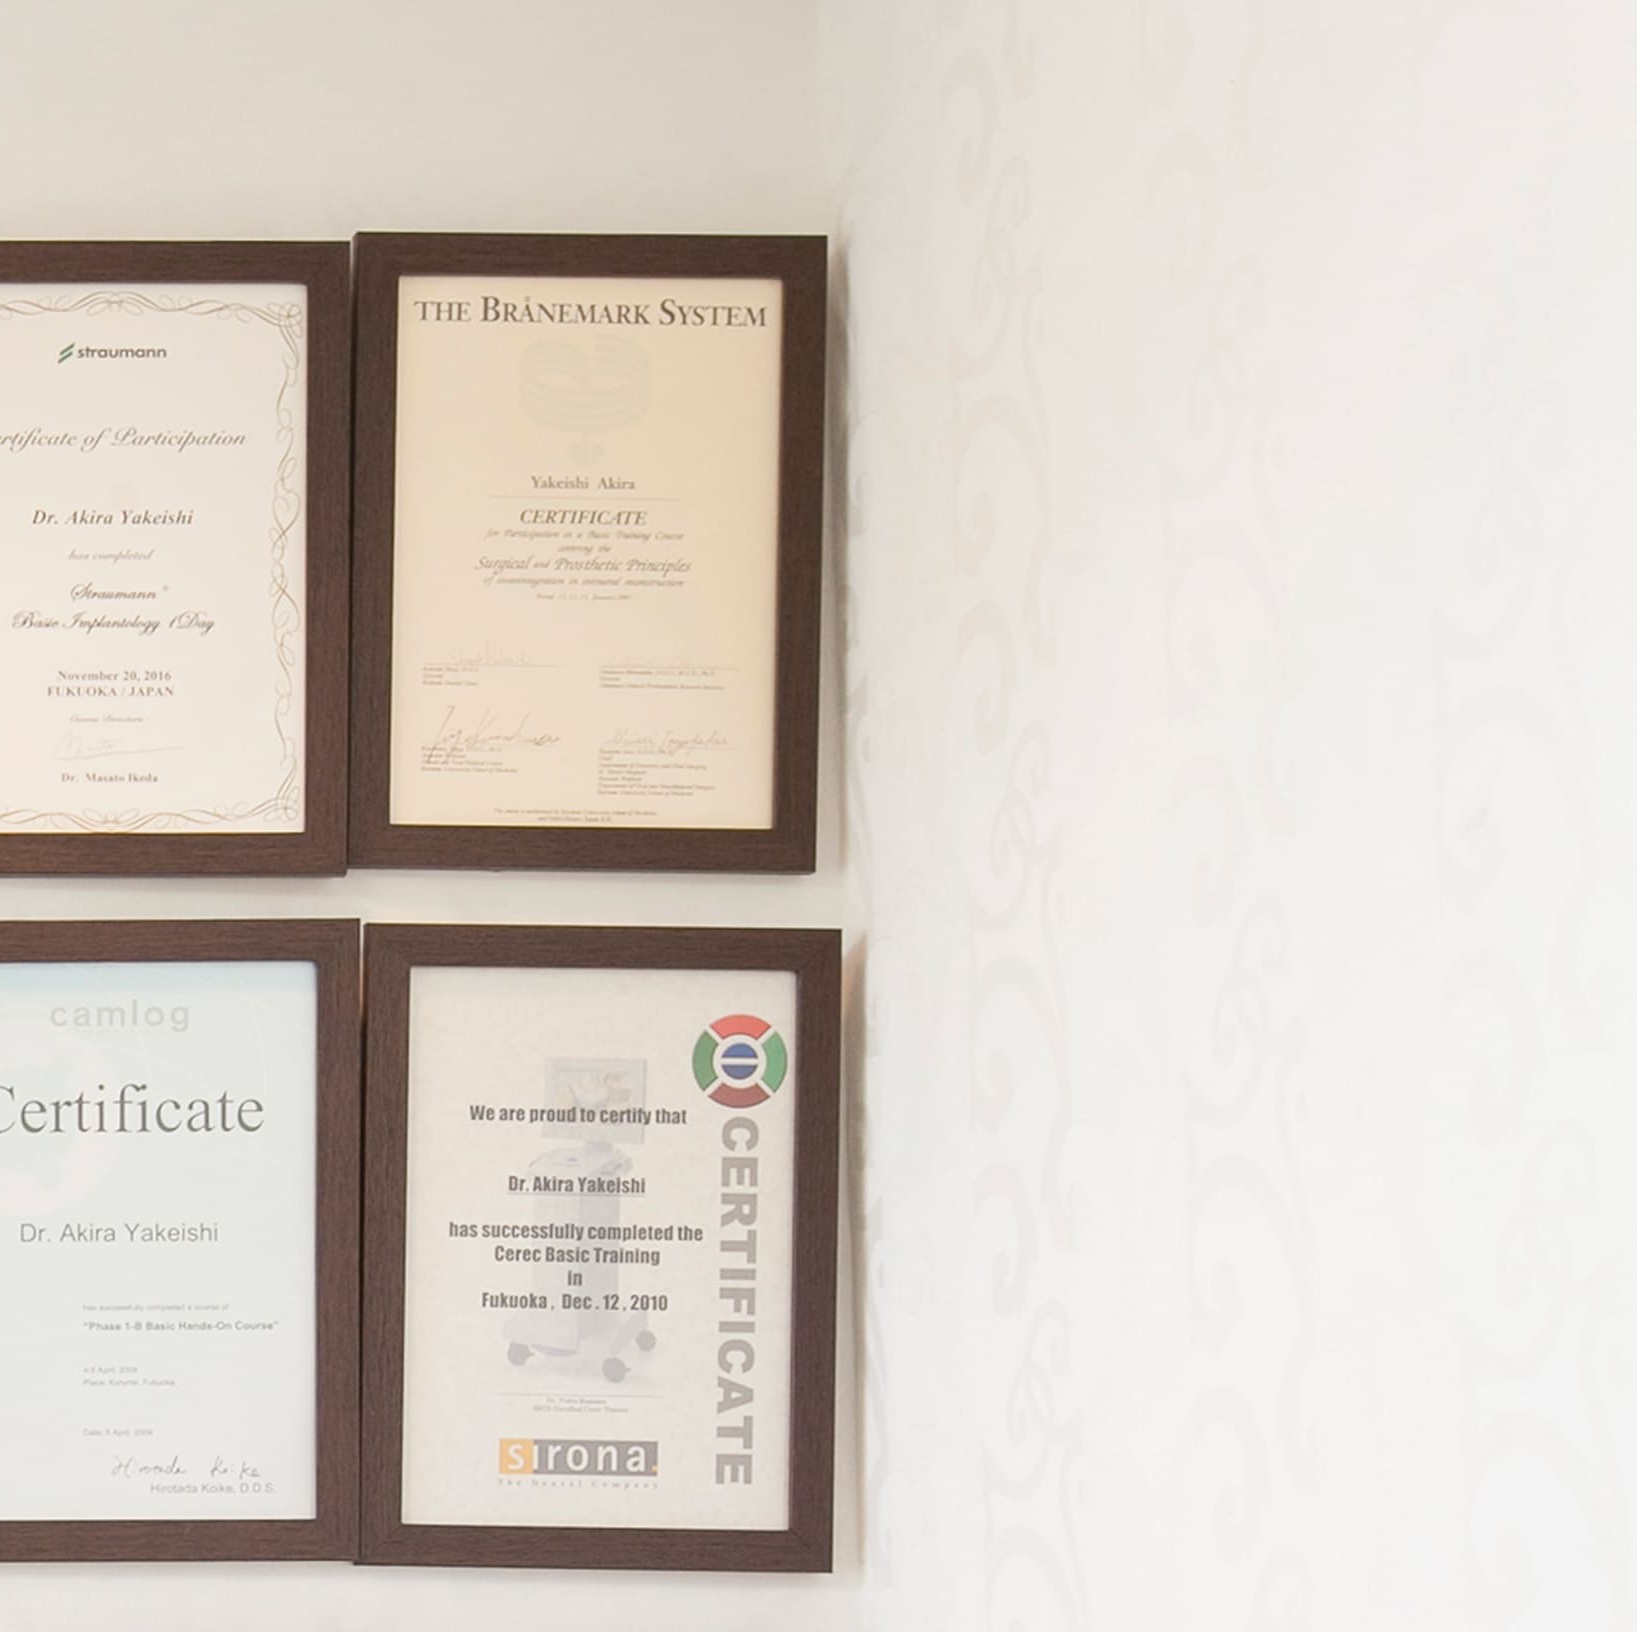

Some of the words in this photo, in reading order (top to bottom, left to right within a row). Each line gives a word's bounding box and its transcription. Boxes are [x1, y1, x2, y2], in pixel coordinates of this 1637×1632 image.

[413, 301, 472, 322] THE
[659, 299, 767, 327] SYSTEM
[77, 346, 167, 359] straumann
[81, 428, 111, 453] of
[111, 426, 246, 453] Participation
[531, 475, 590, 491] Yakeishi
[597, 477, 635, 491] Akira
[32, 510, 59, 525] Dr.
[64, 510, 113, 526] Akira
[120, 510, 194, 525] Yakeishi
[519, 509, 646, 526] CERTIFICATE
[11, 611, 60, 631] Basic
[62, 611, 160, 634] Implantology
[58, 670, 121, 682] November
[124, 670, 140, 684] 20,
[143, 670, 171, 682] 2016
[48, 685, 118, 698] FUKUOKA
[129, 685, 175, 698] JAPAN
[128, 772, 158, 783] Ikeda
[50, 999, 190, 1032] camlog
[470, 1105, 495, 1121] We
[499, 1107, 525, 1122] are
[530, 1106, 577, 1126] proud
[580, 1108, 596, 1123] to
[600, 1107, 651, 1127] certify
[656, 1109, 687, 1124] that
[509, 1176, 529, 1192] Dr.
[533, 1176, 574, 1193] Akira
[578, 1177, 646, 1194] Yakeishi
[20, 1224, 52, 1243] Dr.
[60, 1224, 116, 1243] Akira
[125, 1223, 219, 1243] Yakeishi
[449, 1223, 478, 1239] has
[482, 1222, 584, 1242] successfully
[588, 1224, 674, 1242] completed
[677, 1225, 704, 1241] the
[495, 1246, 542, 1263] Cerec
[546, 1247, 590, 1264] Basic
[594, 1247, 660, 1267] Training
[568, 1270, 583, 1286] in
[630, 1294, 668, 1312] 2010
[715, 1115, 760, 1487] CERTIFICATE
[146, 1322, 175, 1331] Basic
[179, 1322, 232, 1330] Hands-On
